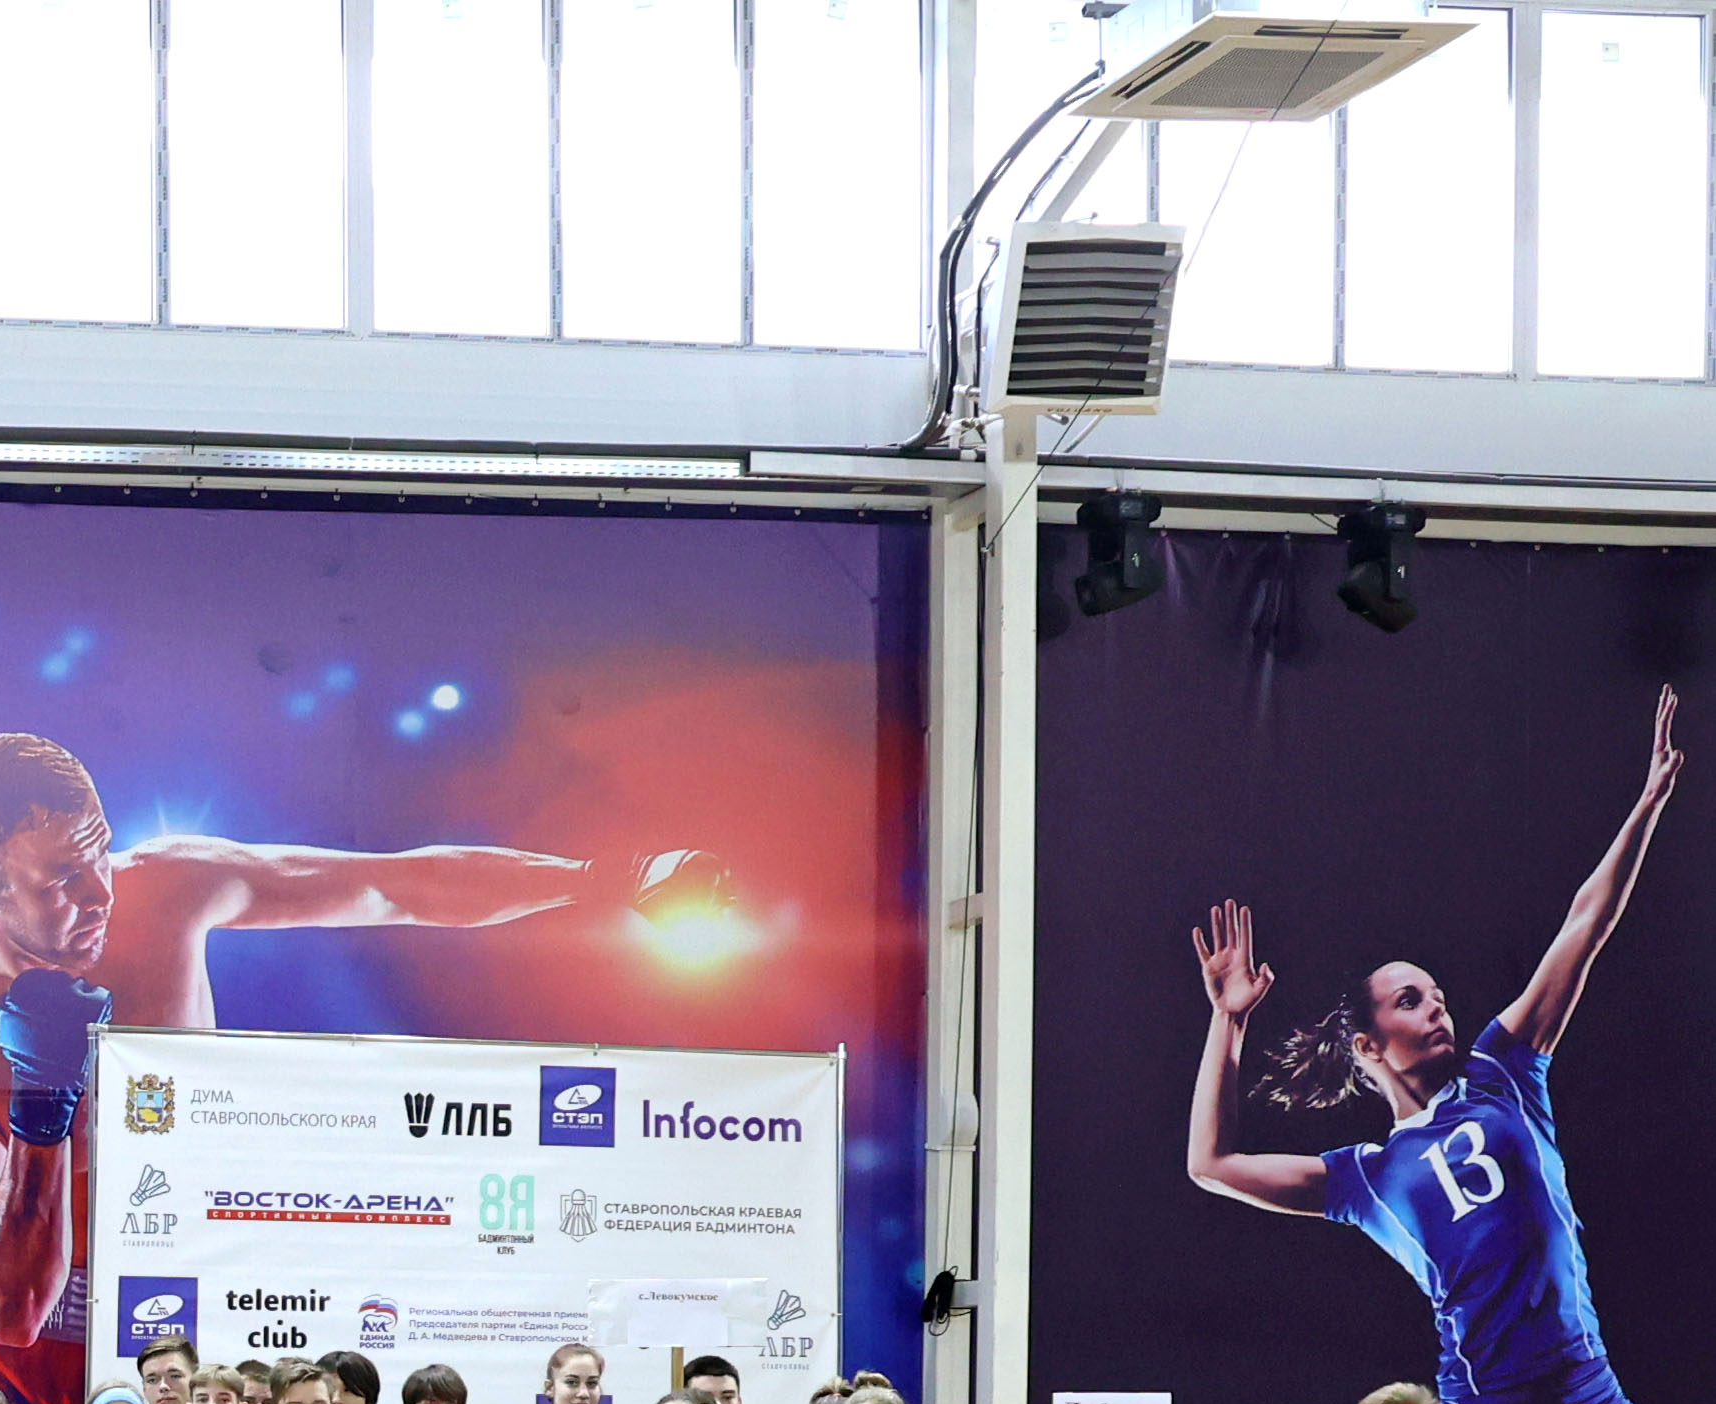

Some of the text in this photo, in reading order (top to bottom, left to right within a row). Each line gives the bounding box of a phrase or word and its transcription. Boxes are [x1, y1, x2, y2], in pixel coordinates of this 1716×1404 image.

[190, 1089, 234, 1105] ДУМА
[190, 1110, 377, 1129] СТАВРОПОЛЬСКОГО КРАЯ
[552, 1112, 603, 1125] СТЭП
[642, 1099, 802, 1142] Infocom
[1418, 1121, 1505, 1223] 13
[212, 1211, 447, 1223] СПОРТИВНЫЙ КОМПЛЕКС
[604, 1203, 802, 1218] СТАВРОПОЛЬСКАЯ КРАЕВАЯ
[604, 1219, 796, 1235] ФЕДЕРАЦИЯ БАДМИНТОНА
[497, 1246, 515, 1255] КЛУБ
[226, 1289, 331, 1312] telemir
[409, 1307, 479, 1317] Региональная
[481, 1308, 552, 1319] общественная
[131, 1323, 185, 1335] СТЭП
[409, 1319, 479, 1329] Председателя
[481, 1322, 516, 1331] партии
[247, 1322, 308, 1348] club
[359, 1334, 395, 1342] ЕДИНАЯ
[433, 1332, 488, 1342] Медведева
[498, 1333, 579, 1344] Ставропольском
